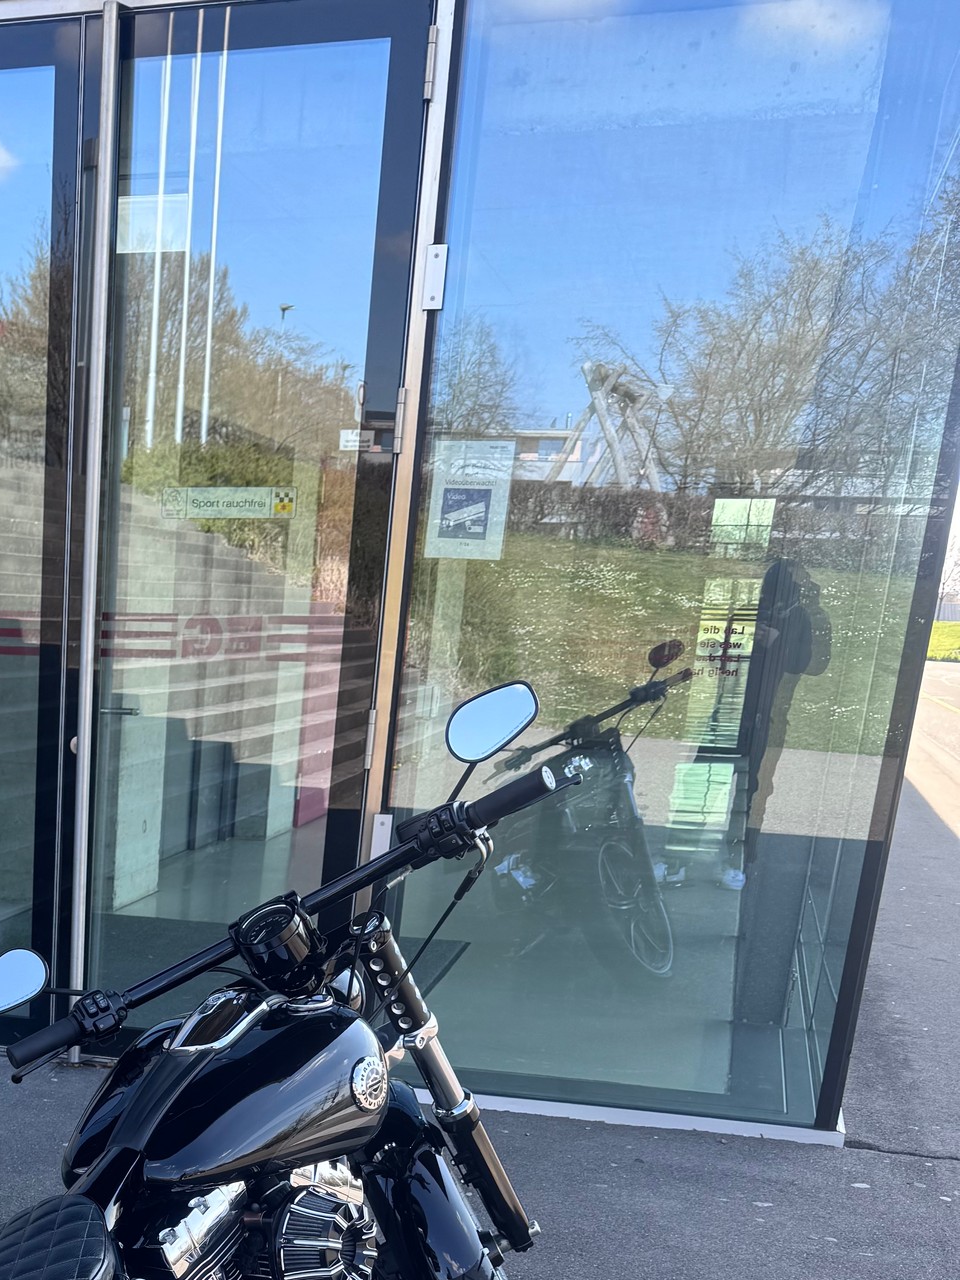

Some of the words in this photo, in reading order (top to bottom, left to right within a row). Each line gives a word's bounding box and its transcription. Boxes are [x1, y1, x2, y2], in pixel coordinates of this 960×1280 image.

[447, 492, 466, 500] Video
[191, 498, 220, 510] Sport
[221, 497, 267, 509] rauchfrei
